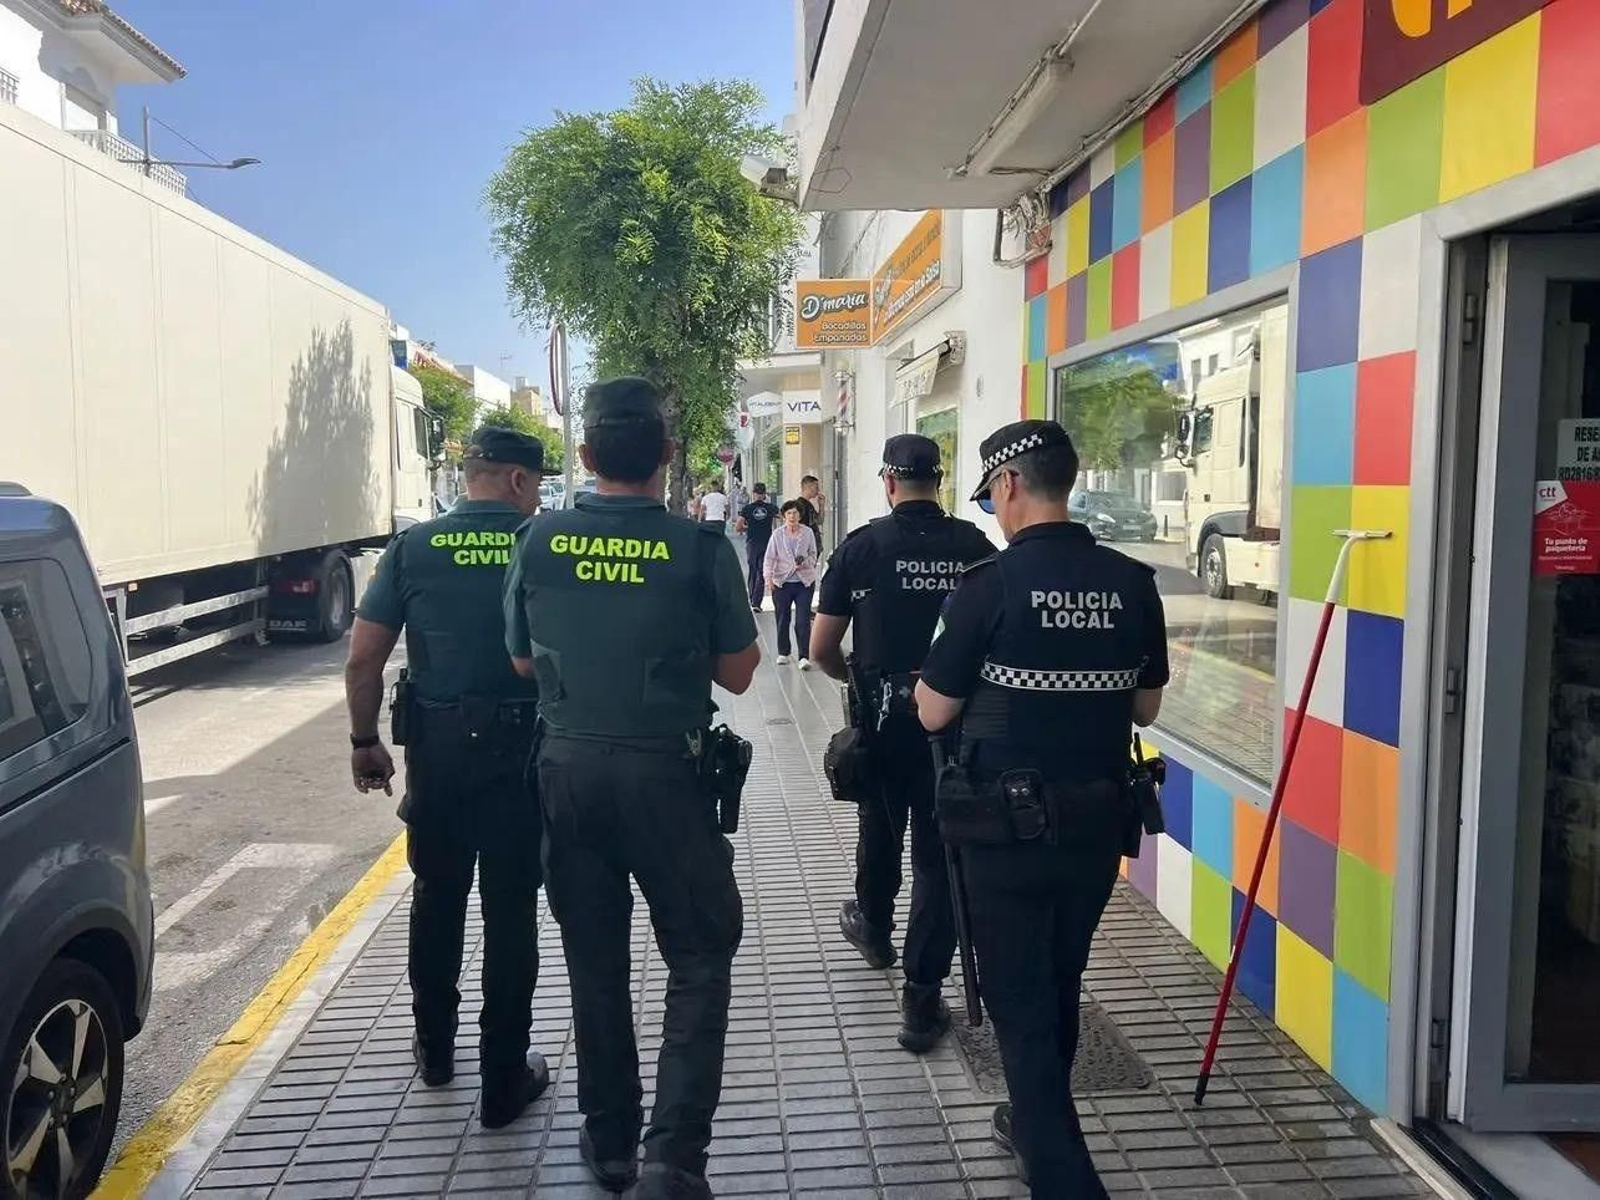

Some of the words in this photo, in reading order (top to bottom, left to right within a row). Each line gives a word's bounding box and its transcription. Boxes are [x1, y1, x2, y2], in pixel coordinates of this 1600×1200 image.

[822, 320, 866, 331] Bocadillos
[787, 401, 821, 412] VITA
[1577, 446, 1590, 462] DE
[1539, 487, 1556, 498] ctt
[430, 532, 516, 547] GUARDI
[550, 534, 670, 560] GUARDIA
[453, 549, 510, 566] CIVIL
[575, 560, 645, 583] CIVIL
[901, 576, 957, 591] LOCAL
[1031, 590, 1123, 610] POLICIA
[1041, 610, 1115, 629] LOCAL
